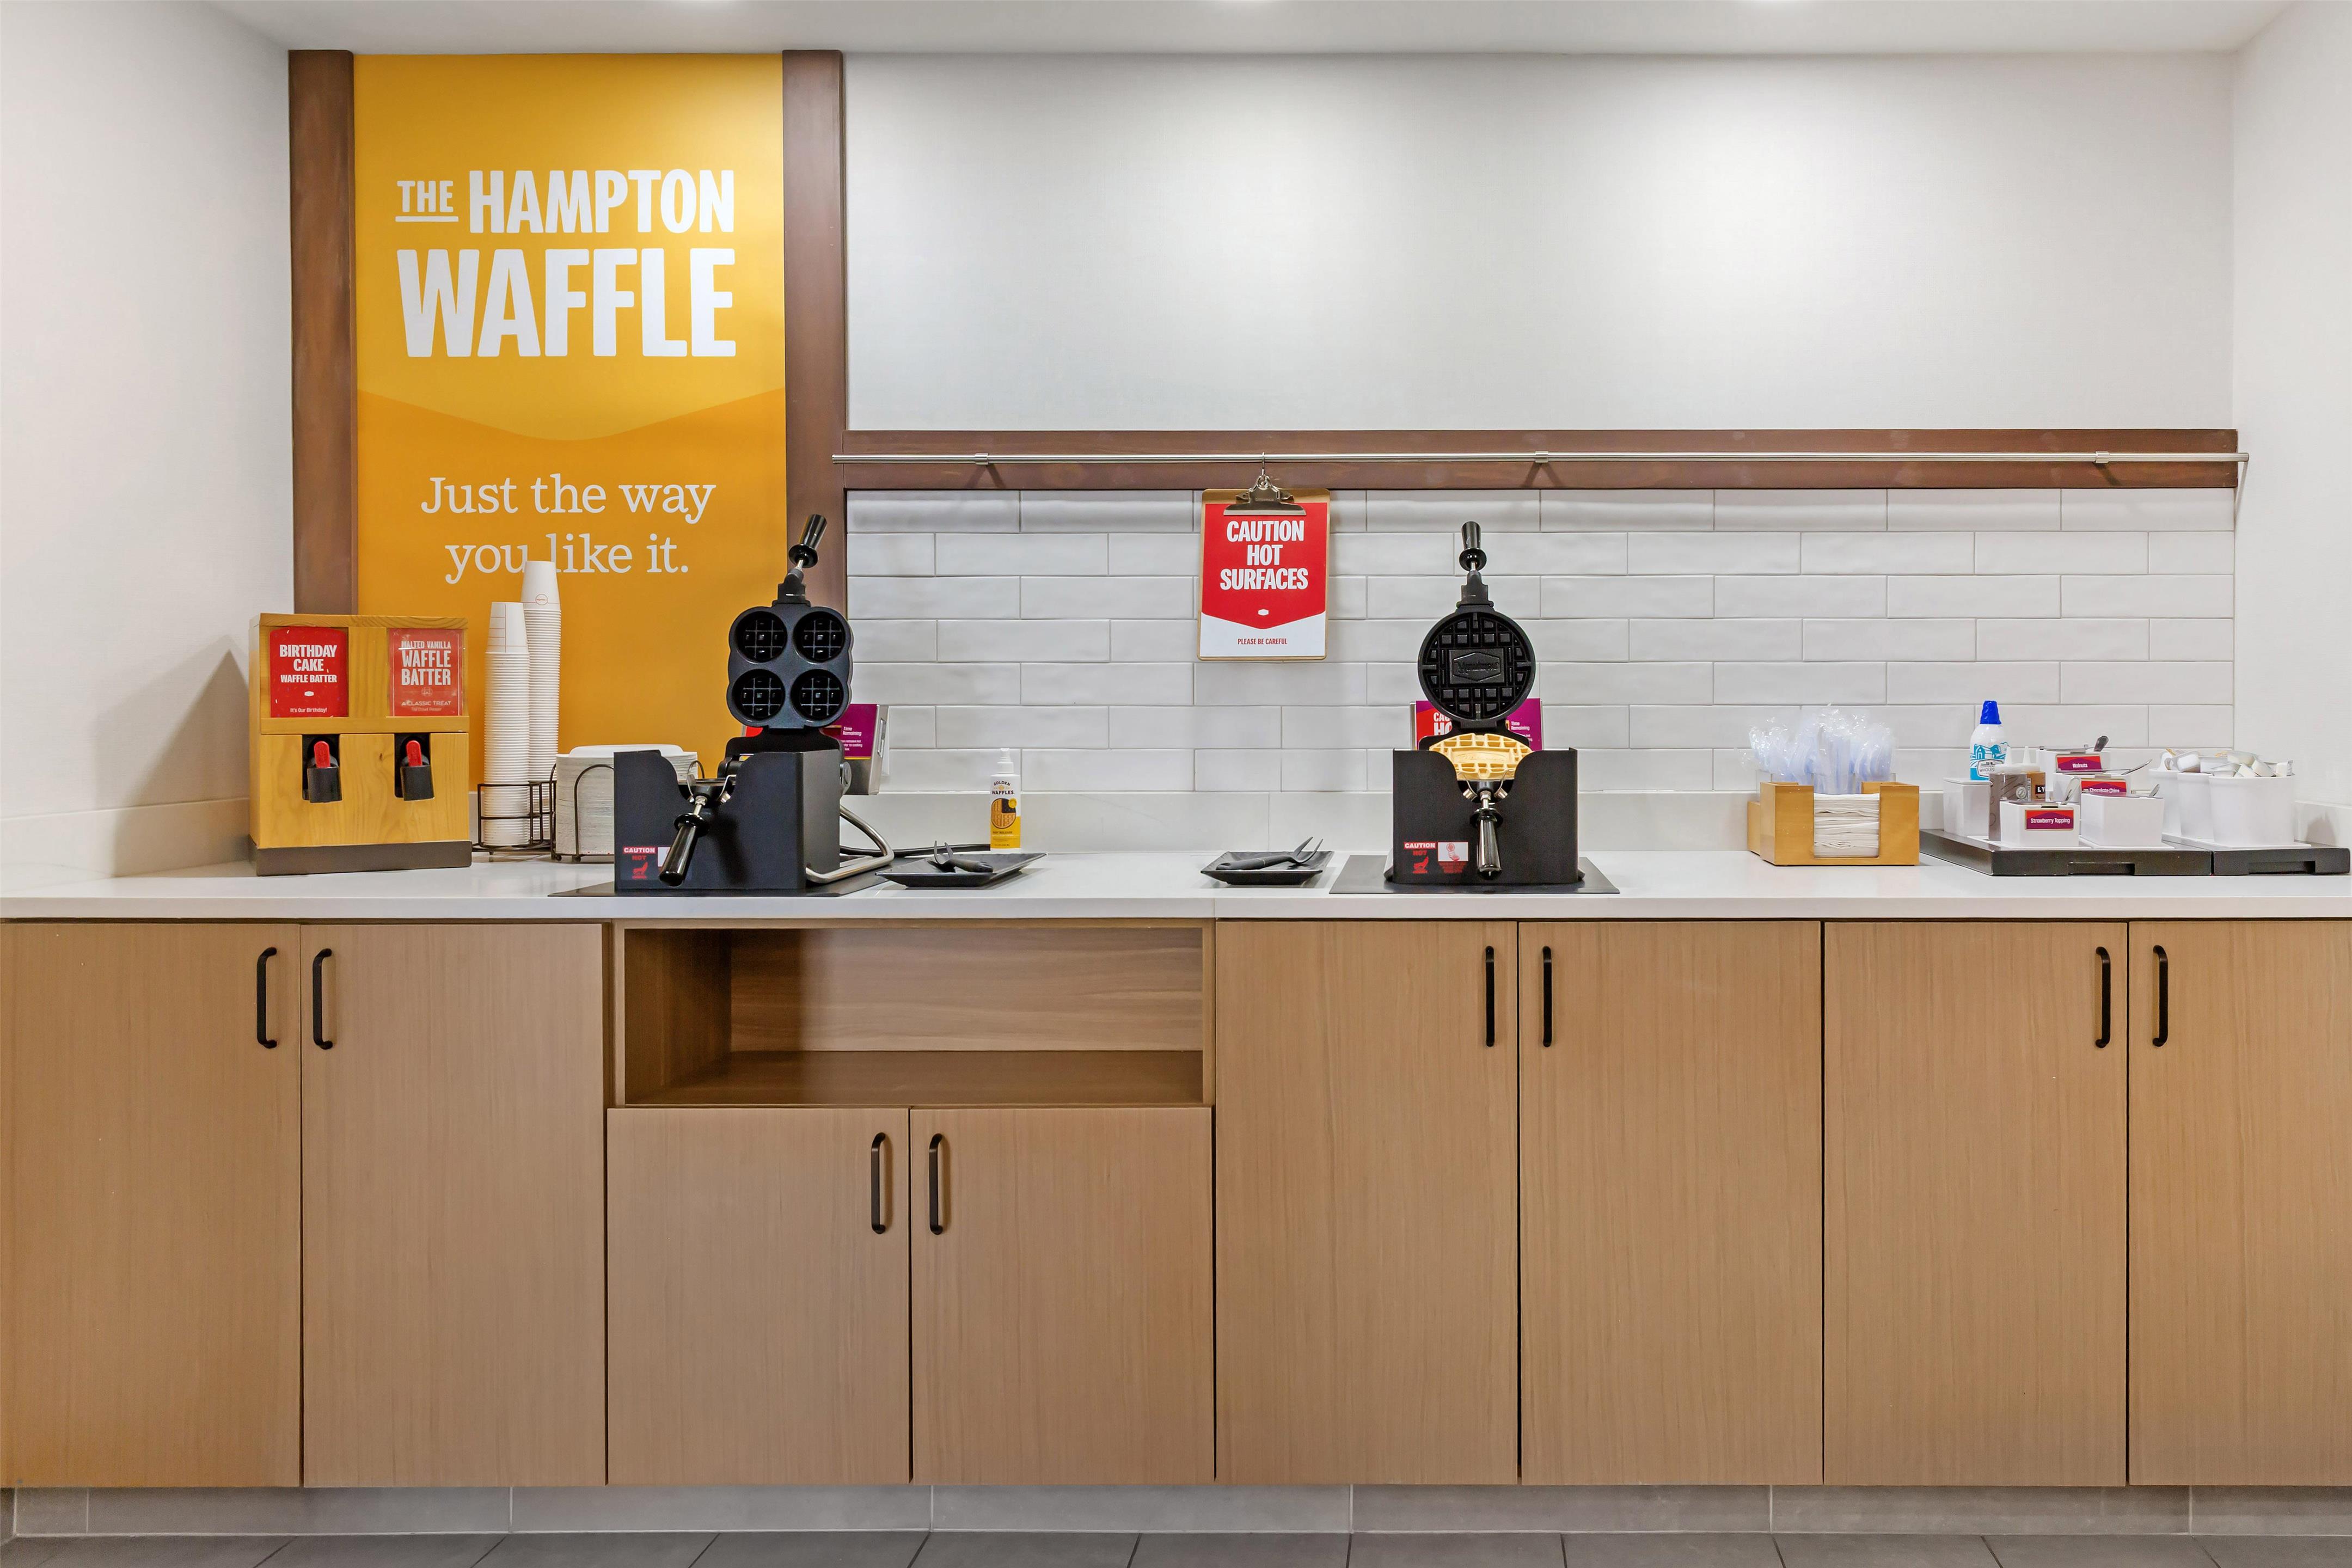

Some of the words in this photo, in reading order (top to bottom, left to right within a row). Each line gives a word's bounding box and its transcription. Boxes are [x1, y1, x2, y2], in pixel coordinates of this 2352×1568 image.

[396, 180, 454, 212] THE
[469, 169, 734, 234] HAMPTON
[396, 248, 736, 357] WAFFLE
[421, 477, 519, 513] Just
[530, 473, 607, 513] the
[618, 485, 716, 524] way
[1227, 520, 1304, 542] CAUTION
[445, 545, 528, 584] you
[546, 533, 633, 573] like
[646, 533, 689, 573] it.
[1247, 544, 1283, 566] HOT
[1220, 568, 1308, 590] SURFACES
[279, 644, 338, 658] BIRTHDAY
[427, 641, 451, 649] VANILLA
[293, 658, 324, 671] CAKE
[401, 650, 451, 667] WAFFLE
[280, 675, 308, 683] WAFFLE
[310, 675, 338, 683] BATTER
[401, 668, 451, 686] BATTER
[1434, 712, 1450, 722] CAU
[1434, 722, 1453, 736] HO
